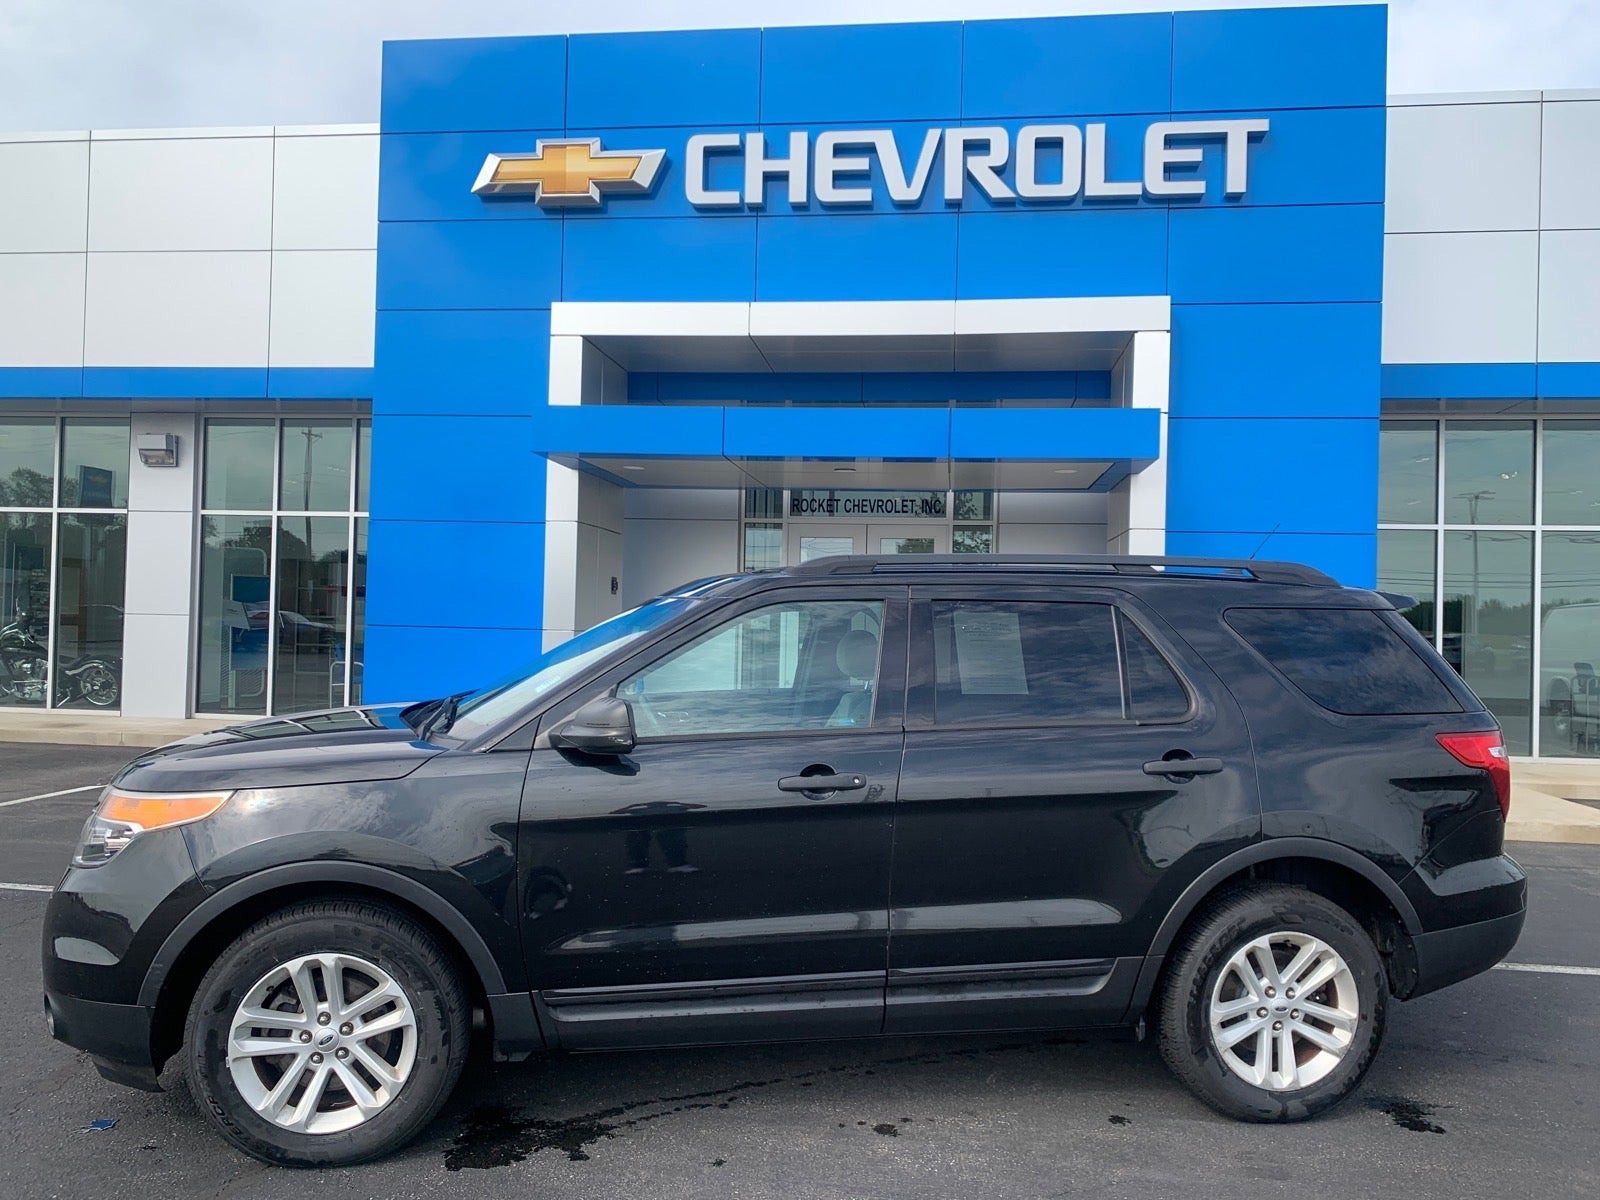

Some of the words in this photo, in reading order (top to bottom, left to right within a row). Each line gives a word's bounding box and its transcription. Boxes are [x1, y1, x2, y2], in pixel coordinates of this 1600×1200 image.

[685, 118, 1270, 206] CHEVROLET
[792, 498, 840, 513] ROCKET
[921, 499, 945, 514] INC.
